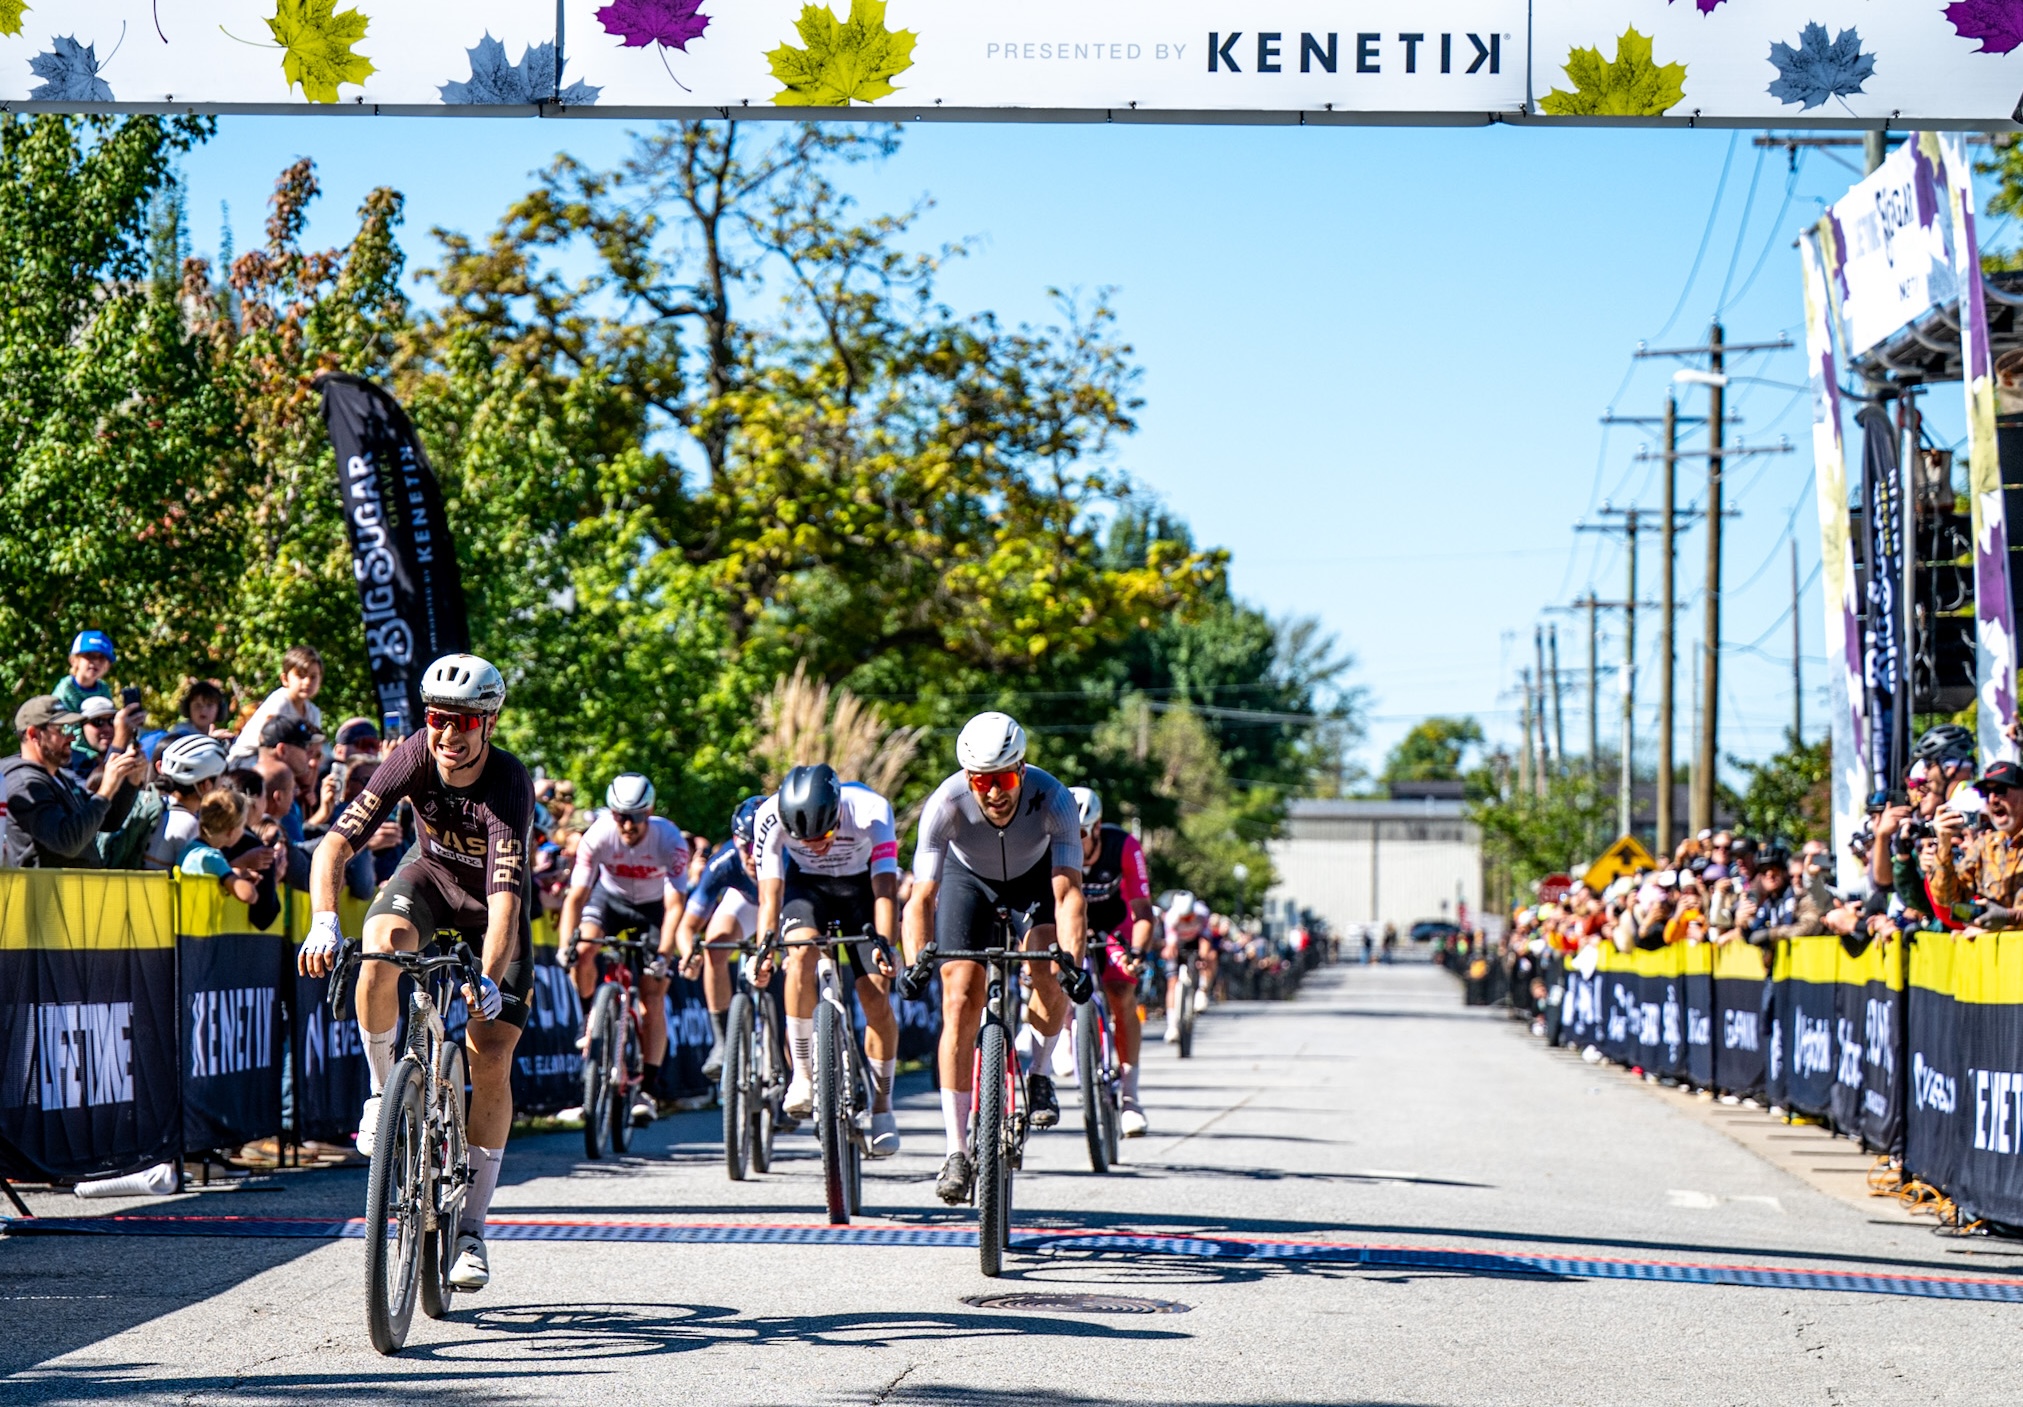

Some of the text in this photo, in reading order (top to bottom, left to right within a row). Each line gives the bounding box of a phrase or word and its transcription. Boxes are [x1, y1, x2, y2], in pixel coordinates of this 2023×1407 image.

[987, 42, 1188, 60] PRESENTED BY
[1207, 32, 1501, 74] KENETIK
[336, 789, 382, 835] PAS
[493, 838, 522, 886] PAS
